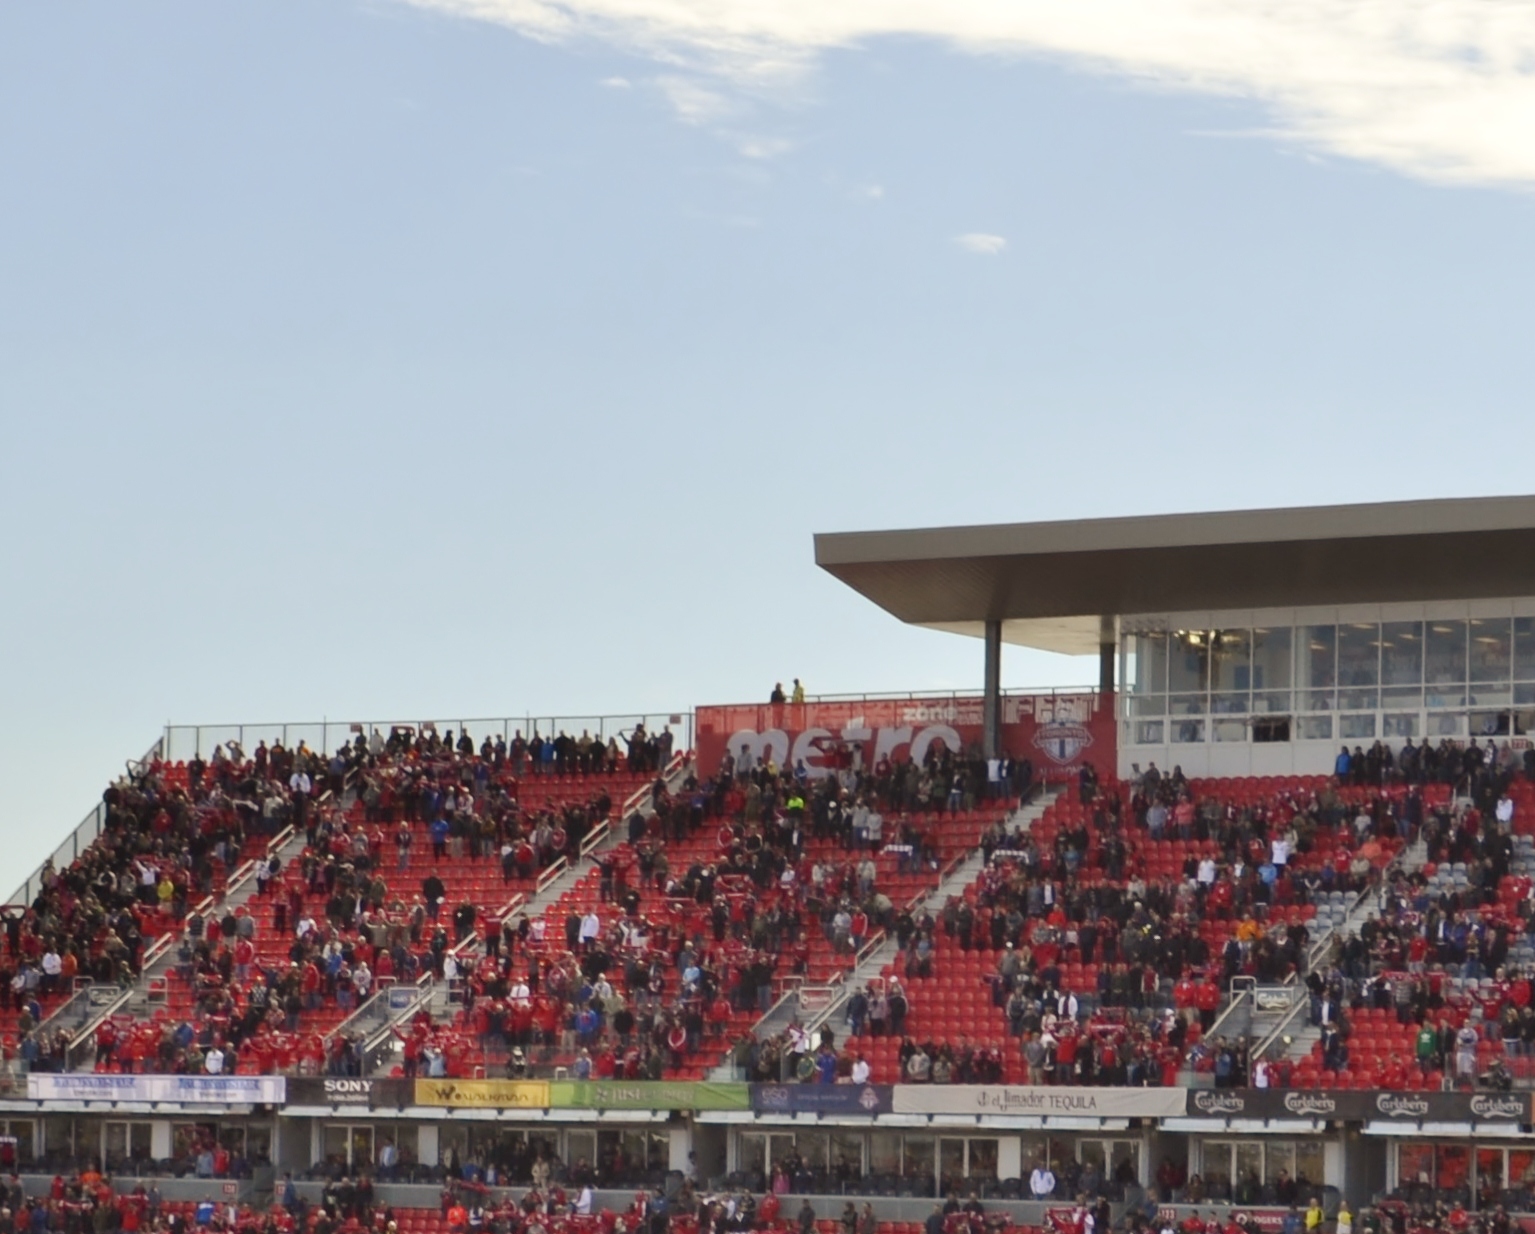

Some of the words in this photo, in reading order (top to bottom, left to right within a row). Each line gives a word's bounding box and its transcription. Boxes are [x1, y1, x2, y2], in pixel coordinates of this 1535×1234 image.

[324, 1080, 372, 1093] SONY
[1049, 1095, 1097, 1109] TEQUILA
[1195, 1091, 1244, 1111] Carlsberg
[1284, 1092, 1335, 1112] Carlsberg
[1376, 1093, 1429, 1113] Carlsberg
[1470, 1094, 1524, 1115] Carlsberg
